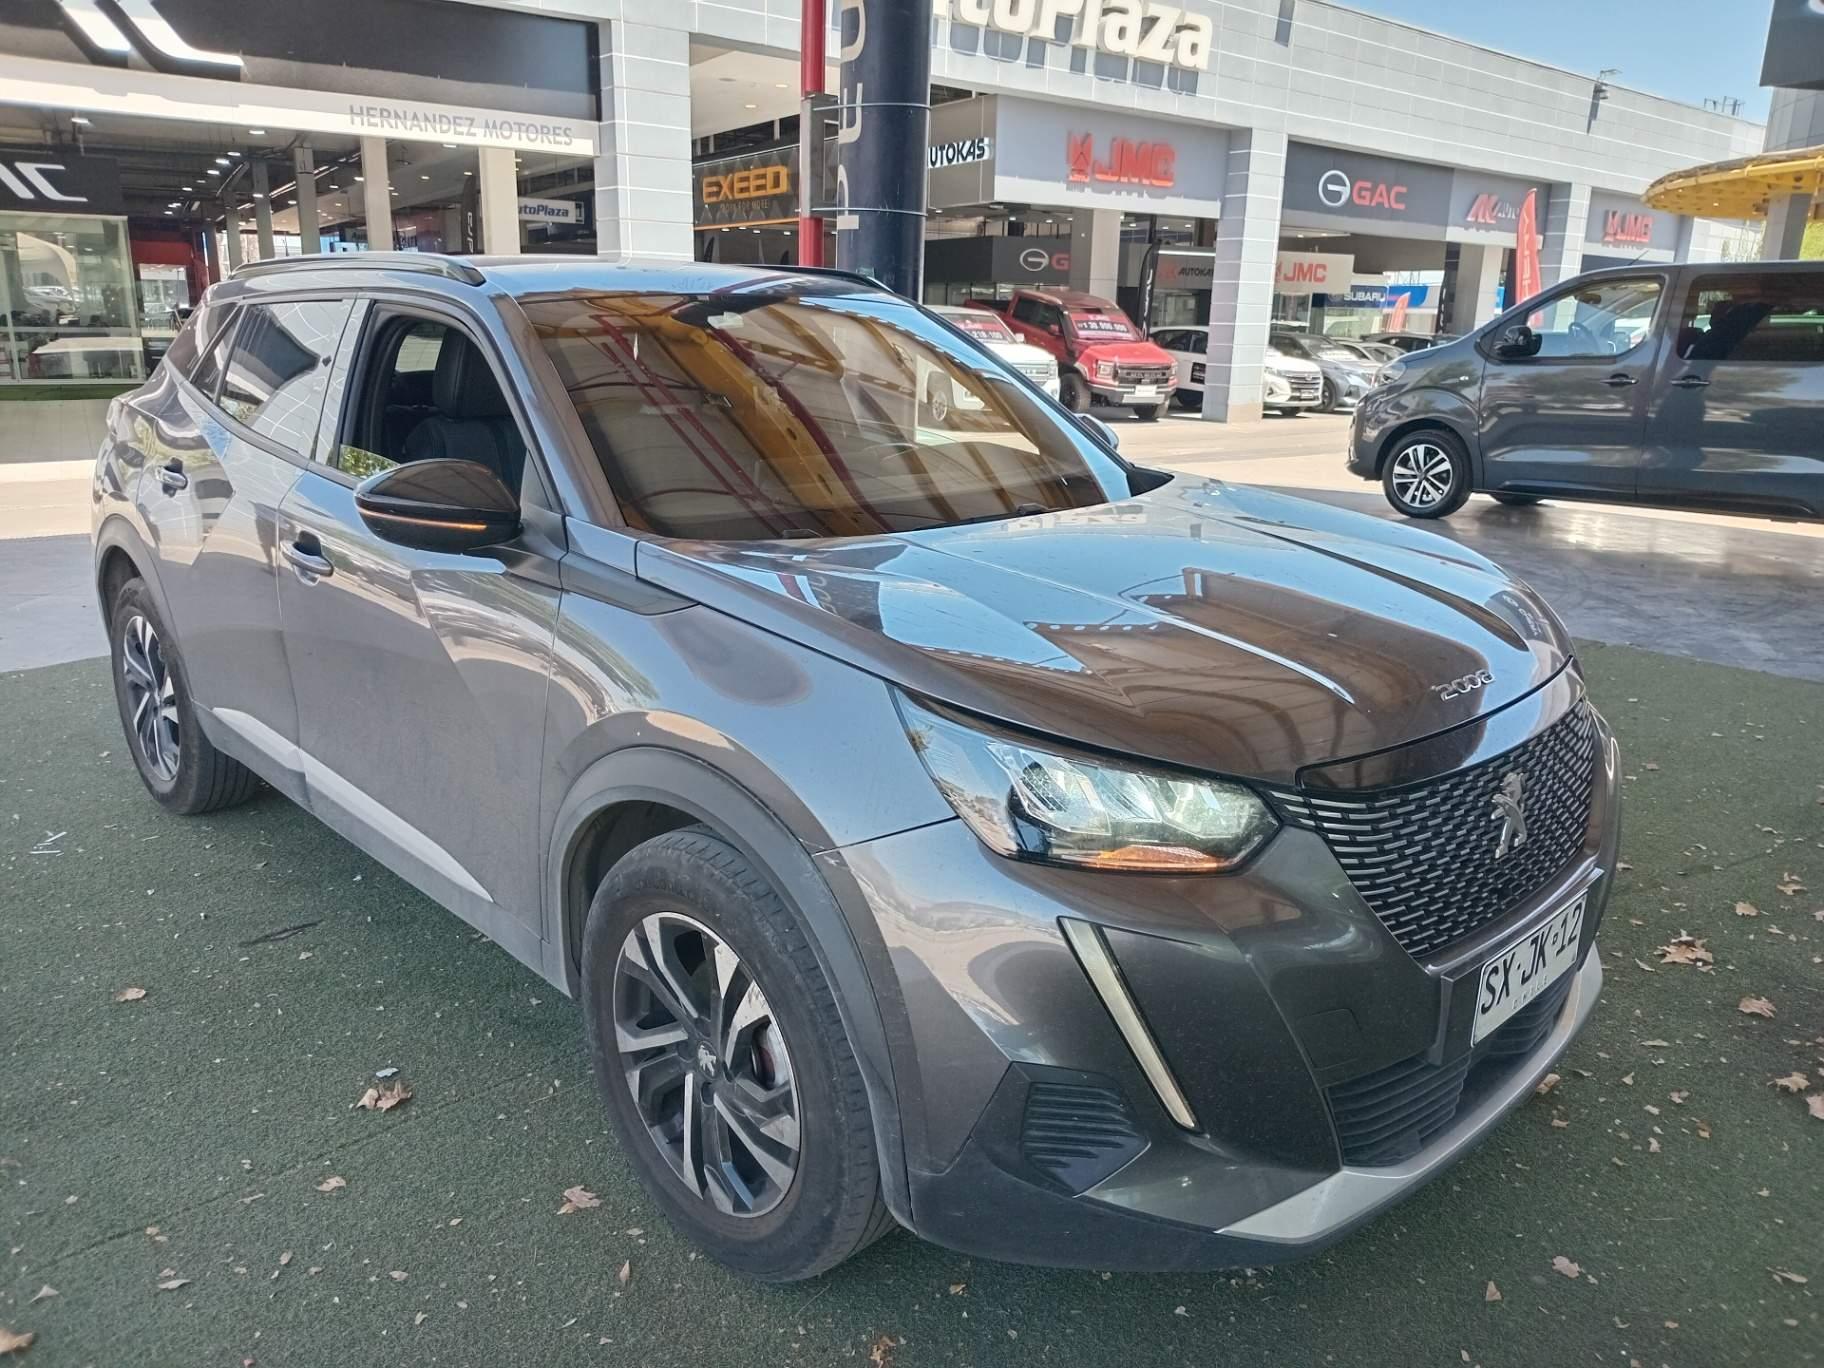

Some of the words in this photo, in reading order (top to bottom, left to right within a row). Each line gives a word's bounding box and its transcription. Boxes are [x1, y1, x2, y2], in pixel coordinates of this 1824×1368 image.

[349, 104, 477, 137] HERNANDEZ
[483, 118, 574, 147] MOTORES
[928, 137, 987, 168] UTOKAS
[1093, 136, 1174, 187] JMC
[703, 164, 789, 204] EXEED
[1352, 180, 1408, 210] GAC
[1615, 213, 1653, 243] JMC
[1283, 262, 1328, 283] JMC
[1343, 291, 1386, 302] SUBARU
[1434, 669, 1496, 702] 2008
